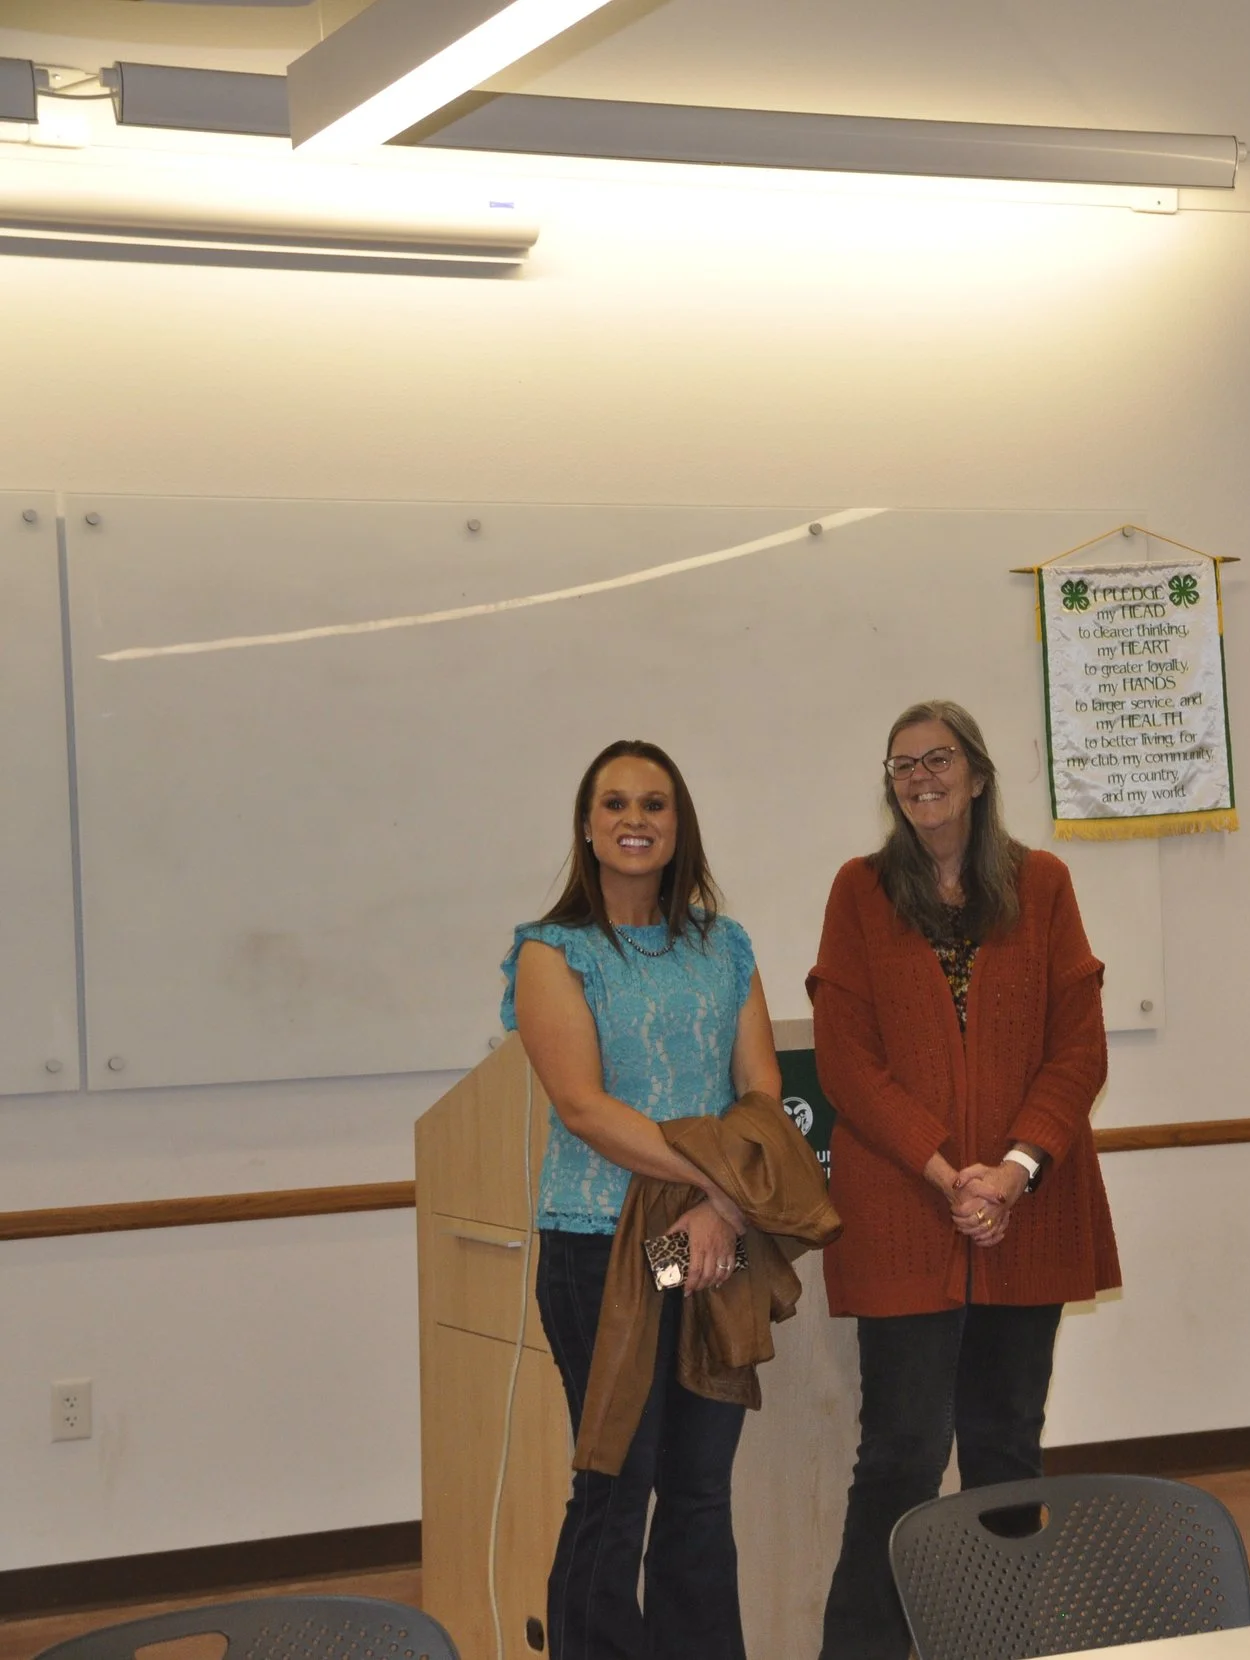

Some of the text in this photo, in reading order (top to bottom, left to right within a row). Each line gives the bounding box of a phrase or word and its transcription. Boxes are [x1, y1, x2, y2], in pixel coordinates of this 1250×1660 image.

[1103, 585, 1165, 602] PLEDGE
[1097, 604, 1166, 623] my HEAD
[1078, 622, 1189, 639] to clearer thinking,
[1097, 639, 1170, 660] my HEART
[1084, 658, 1189, 679] to greater loyalty,
[1098, 675, 1177, 697] my HANDS
[1075, 699, 1088, 712] to
[1092, 698, 1126, 714] larger
[1180, 691, 1202, 707] and
[1095, 711, 1183, 733] my HEALTH
[1084, 736, 1098, 749] to
[1101, 734, 1139, 749] better
[1179, 730, 1197, 743] for
[1066, 755, 1088, 771] my
[1122, 753, 1142, 768] my
[1107, 774, 1127, 788] my
[1102, 789, 1123, 803] and
[1127, 790, 1147, 805] my
